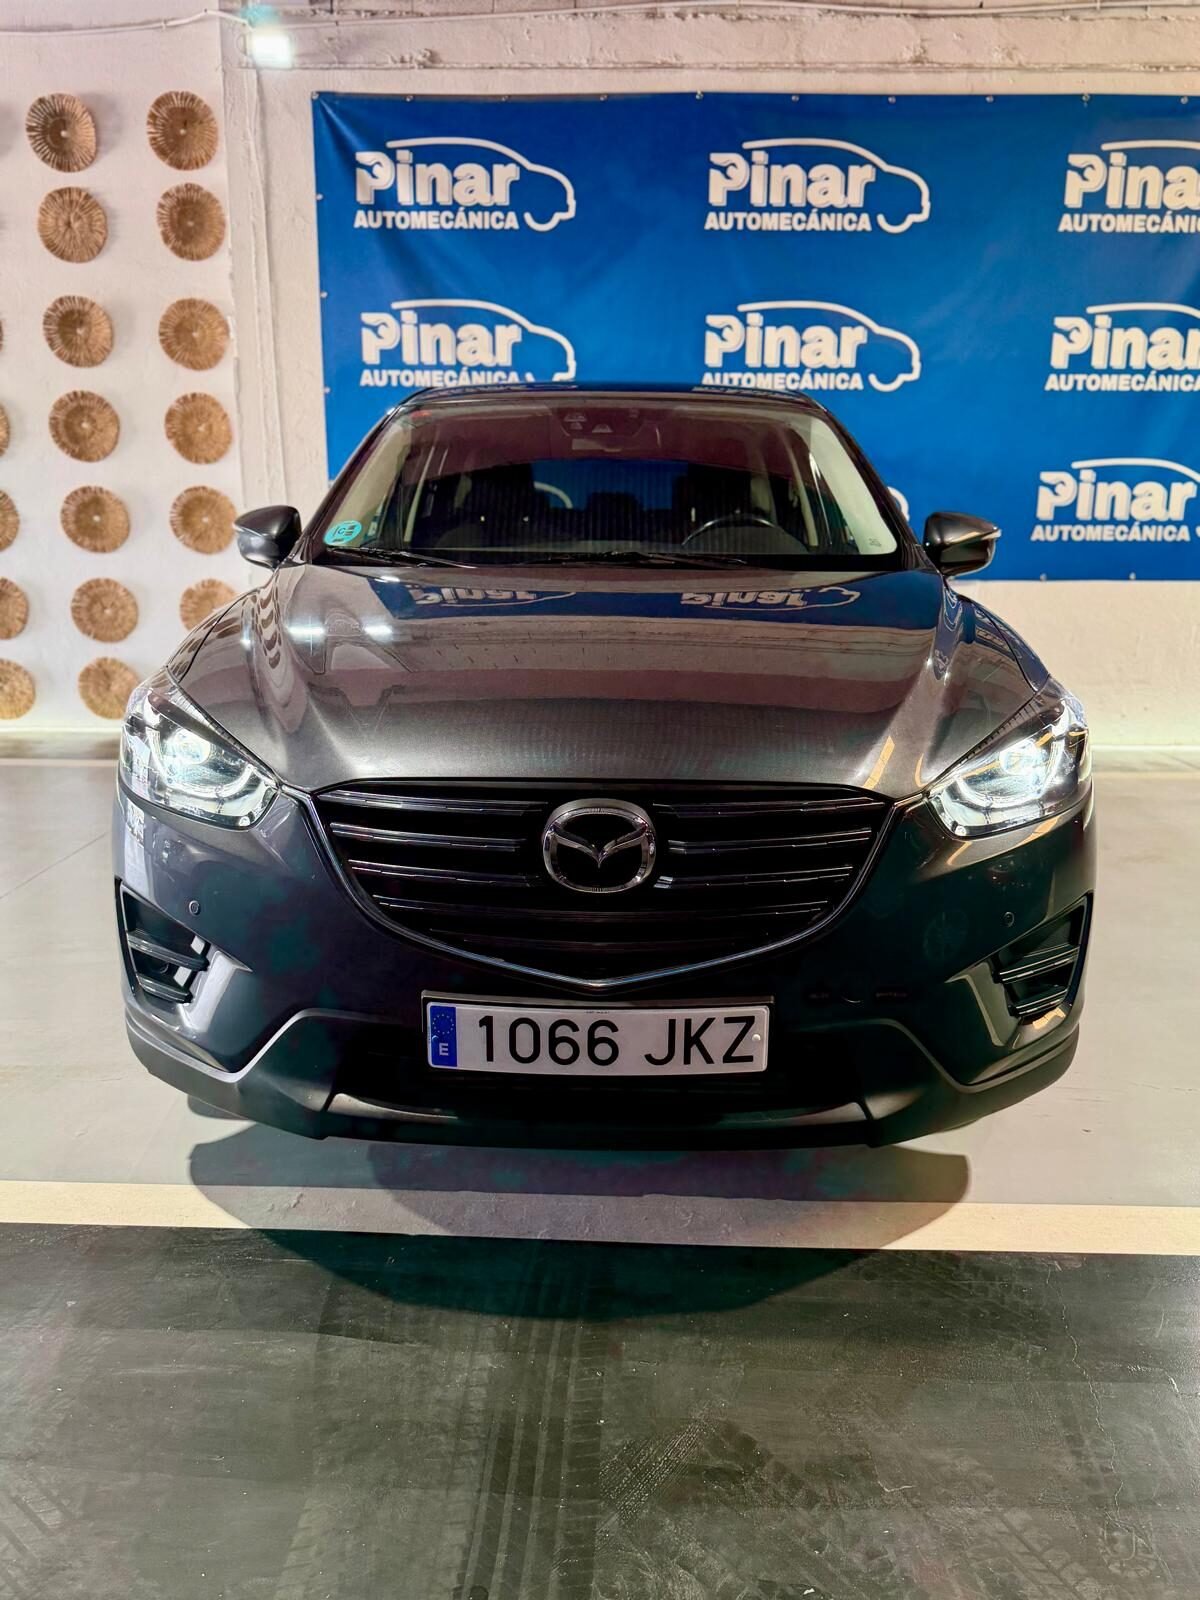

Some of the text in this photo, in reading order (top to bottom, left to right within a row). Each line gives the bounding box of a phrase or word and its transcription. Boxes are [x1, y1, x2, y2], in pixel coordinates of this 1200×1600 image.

[354, 149, 520, 206] Pinar
[708, 150, 876, 207] Pinar
[1064, 152, 1200, 210] Pina
[353, 208, 519, 230] AUTOMECÁNICA
[704, 208, 872, 232] AUTOMECÁNICA
[1058, 211, 1200, 233] AUTOMECÁNI
[360, 310, 522, 366] Pinar
[705, 311, 867, 369] Pinar
[360, 367, 520, 387] AUTOMECÁNICA
[701, 369, 864, 390] AUTOMECÁNICA
[1036, 469, 1198, 521] Pinar
[1030, 521, 1190, 542] AUTOMECÁNICA
[439, 1042, 449, 1056] E
[478, 1015, 756, 1066] 1066 JKZ
